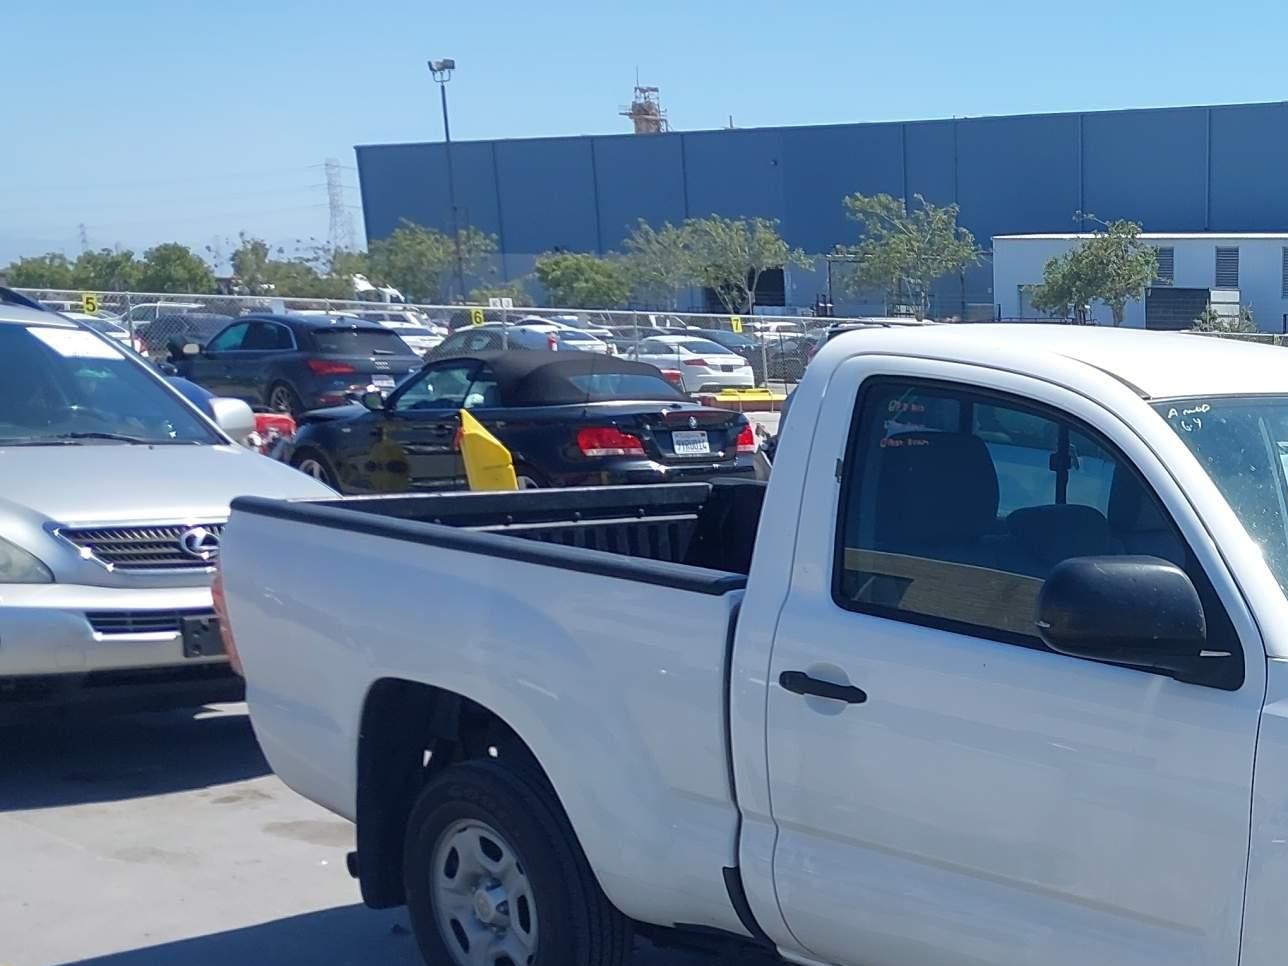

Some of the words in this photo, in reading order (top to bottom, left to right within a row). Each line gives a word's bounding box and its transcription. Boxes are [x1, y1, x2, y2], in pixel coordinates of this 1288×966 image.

[85, 296, 96, 312] 5
[474, 310, 483, 325] 6
[732, 318, 740, 331] 7
